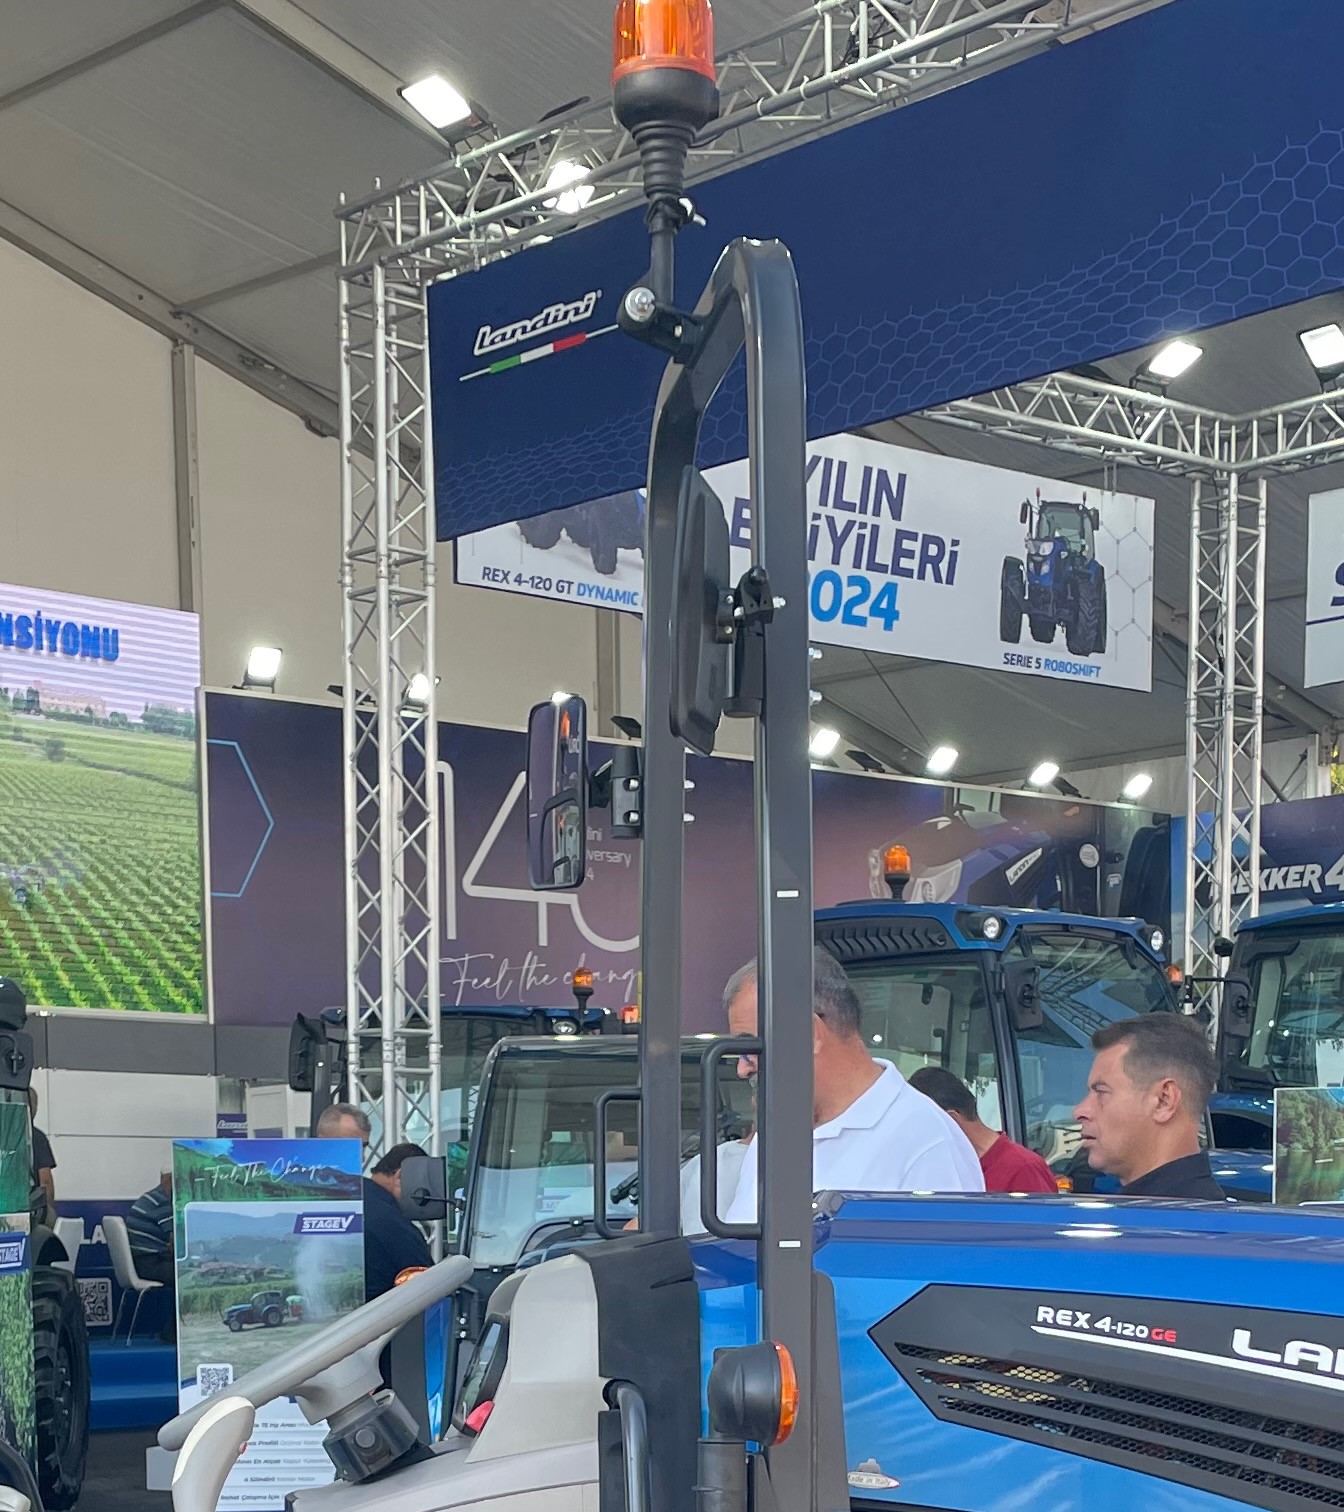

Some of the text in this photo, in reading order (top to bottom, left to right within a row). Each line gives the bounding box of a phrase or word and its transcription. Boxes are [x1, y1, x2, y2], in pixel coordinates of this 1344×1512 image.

[473, 294, 597, 356] Landini
[481, 566, 639, 606] REX 4-120 GT DYNAMIC
[810, 569, 900, 632] 024
[1003, 652, 1102, 679] SERIE 5 ROBOSHIFT
[302, 1215, 355, 1230] STAGE V
[18, 1237, 26, 1262] V
[1036, 1305, 1178, 1344] REX 4-120 GE
